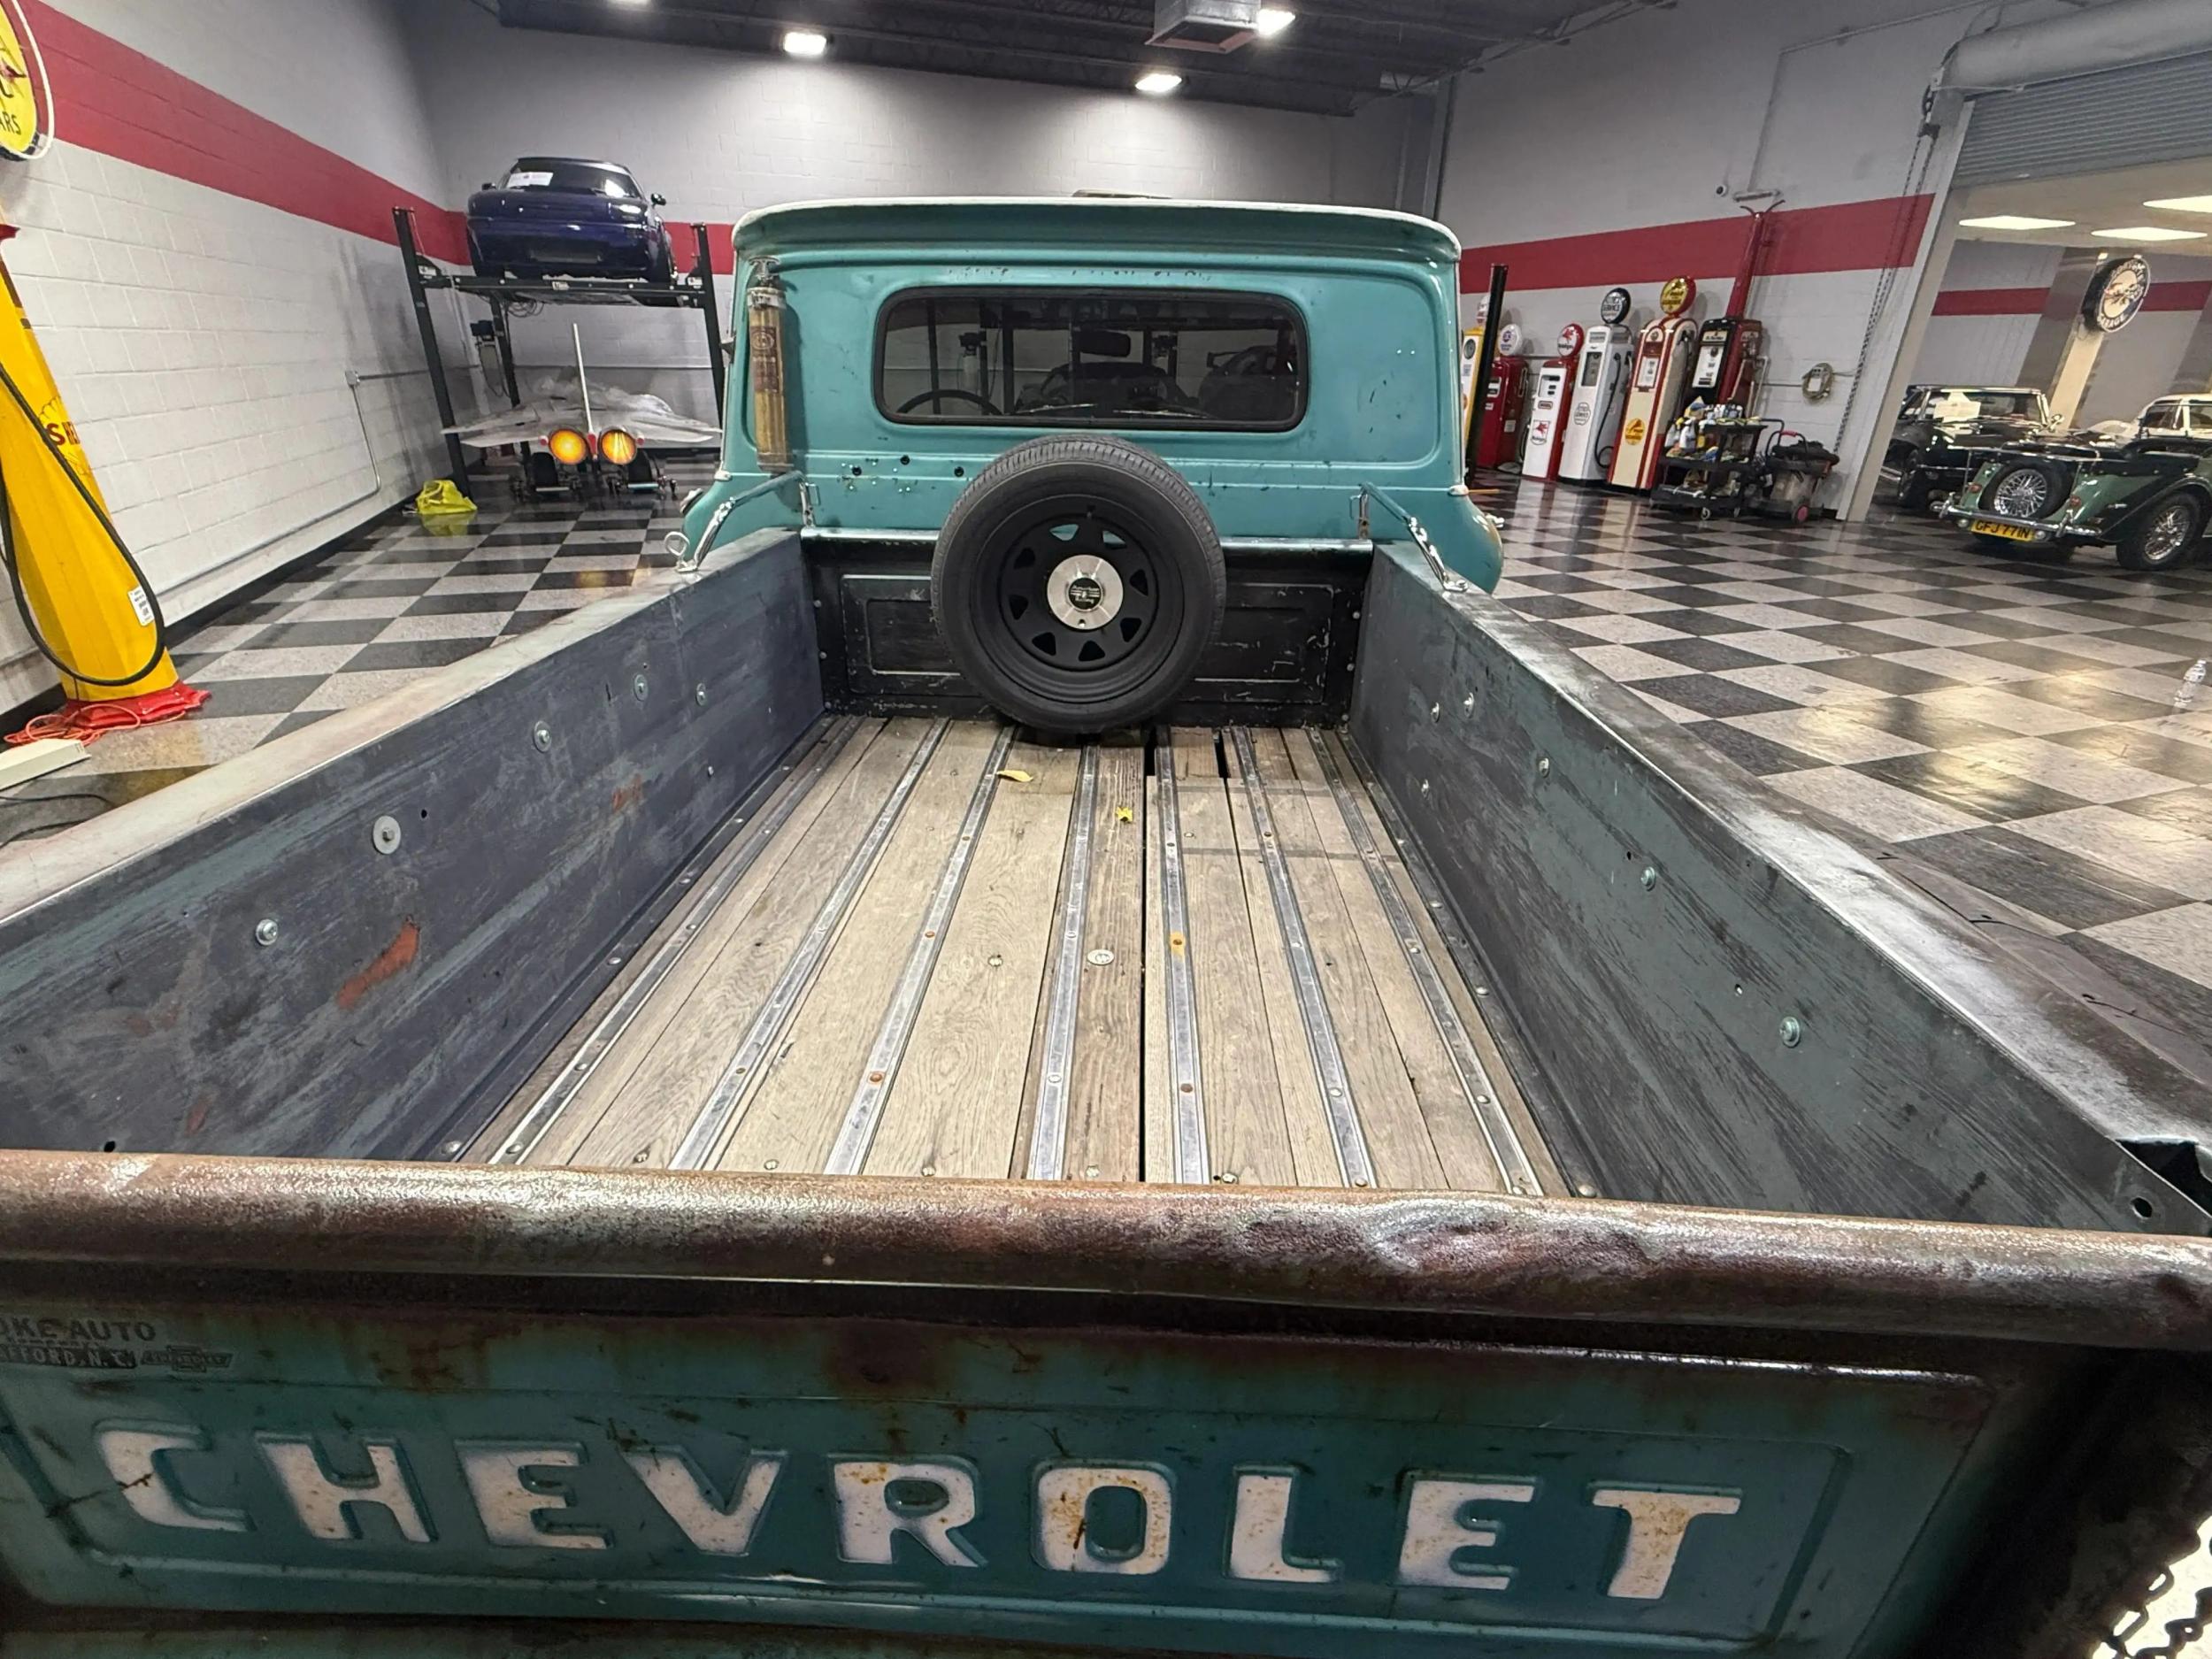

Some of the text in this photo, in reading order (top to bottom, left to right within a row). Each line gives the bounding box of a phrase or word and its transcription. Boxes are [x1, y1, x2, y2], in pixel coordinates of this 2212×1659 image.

[1975, 520, 2001, 534] GFJ
[70, 1318, 157, 1342] AUTO
[96, 1421, 1742, 1600] CHEVROLET
